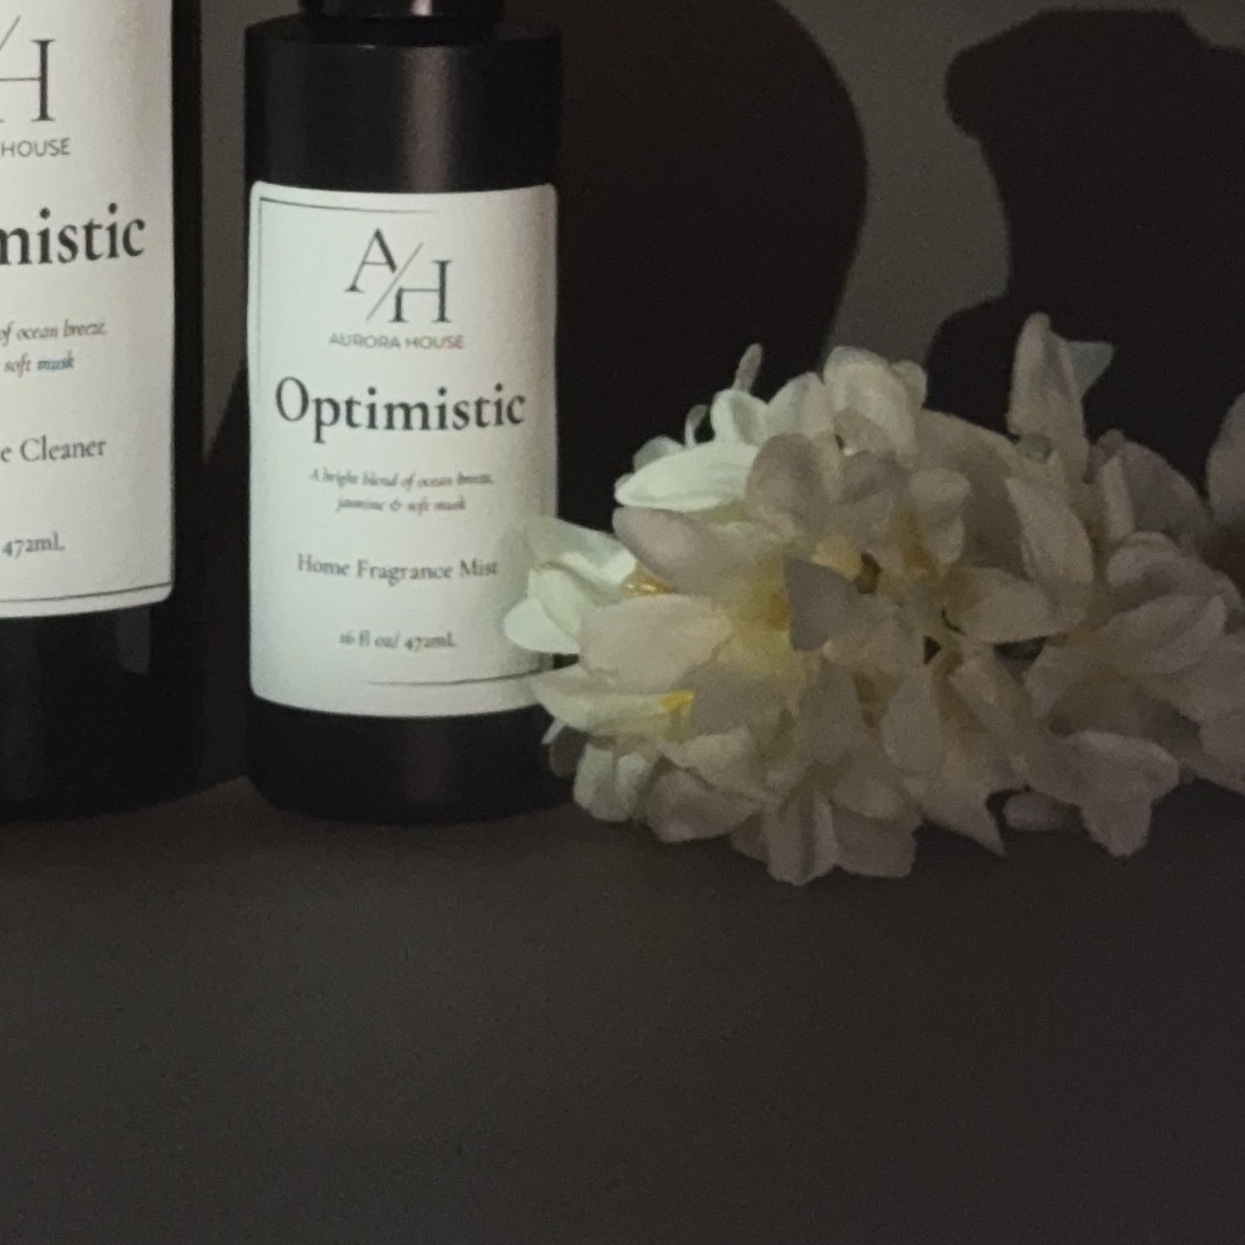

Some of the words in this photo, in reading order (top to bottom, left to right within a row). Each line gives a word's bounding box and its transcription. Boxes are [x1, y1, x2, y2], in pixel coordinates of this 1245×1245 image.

[0, 137, 71, 157] HOUSE
[17, 325, 58, 339] ocean
[329, 333, 401, 349] AURORA
[406, 334, 465, 350] HOUSE
[4, 353, 31, 378] soft
[37, 351, 74, 371] musk
[275, 376, 526, 443] Optimistic
[20, 435, 106, 462] Cleaner
[362, 470, 398, 487] blend
[401, 472, 416, 491] of
[298, 554, 350, 577] Home
[357, 559, 453, 587] Fragrance
[460, 558, 498, 577] Mist
